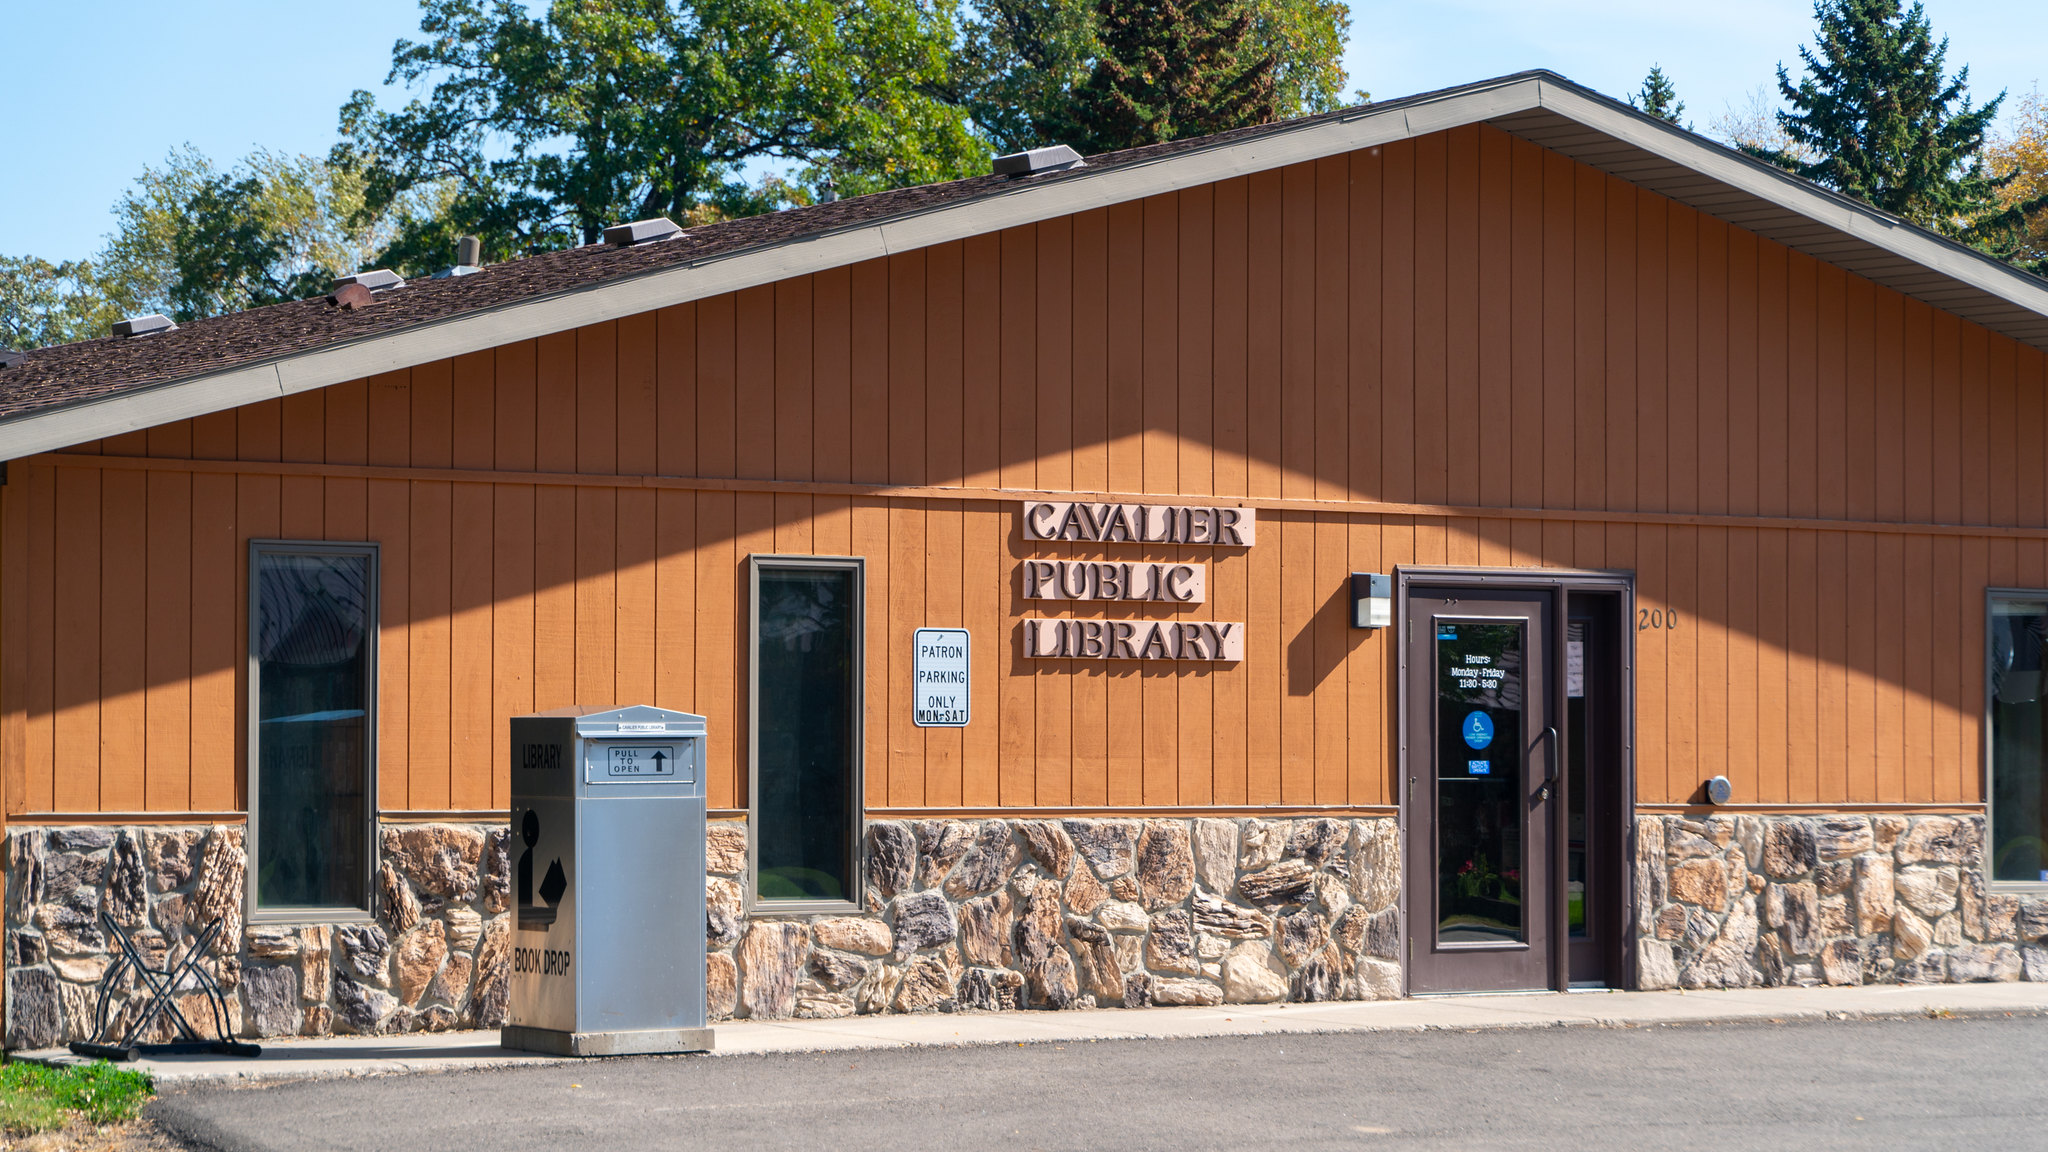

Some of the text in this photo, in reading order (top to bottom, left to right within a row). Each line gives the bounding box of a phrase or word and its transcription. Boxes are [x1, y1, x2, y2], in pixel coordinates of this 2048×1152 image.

[1028, 502, 1244, 545] CAVALIER
[1027, 561, 1194, 601] PUBLIC
[1638, 608, 1678, 631] 200
[1027, 619, 1232, 659] LIBRARY
[922, 645, 963, 658] PATRON
[1465, 654, 1491, 664] Hours:
[919, 671, 965, 684] PARKING
[1451, 667, 1479, 678] Monday
[1482, 668, 1505, 679] Friday
[928, 696, 956, 708] ONLY
[919, 710, 965, 722] MON-SAT
[522, 743, 562, 769] LIBRARY
[614, 765, 640, 773] OPEN
[515, 947, 570, 976] BOOK DROP
